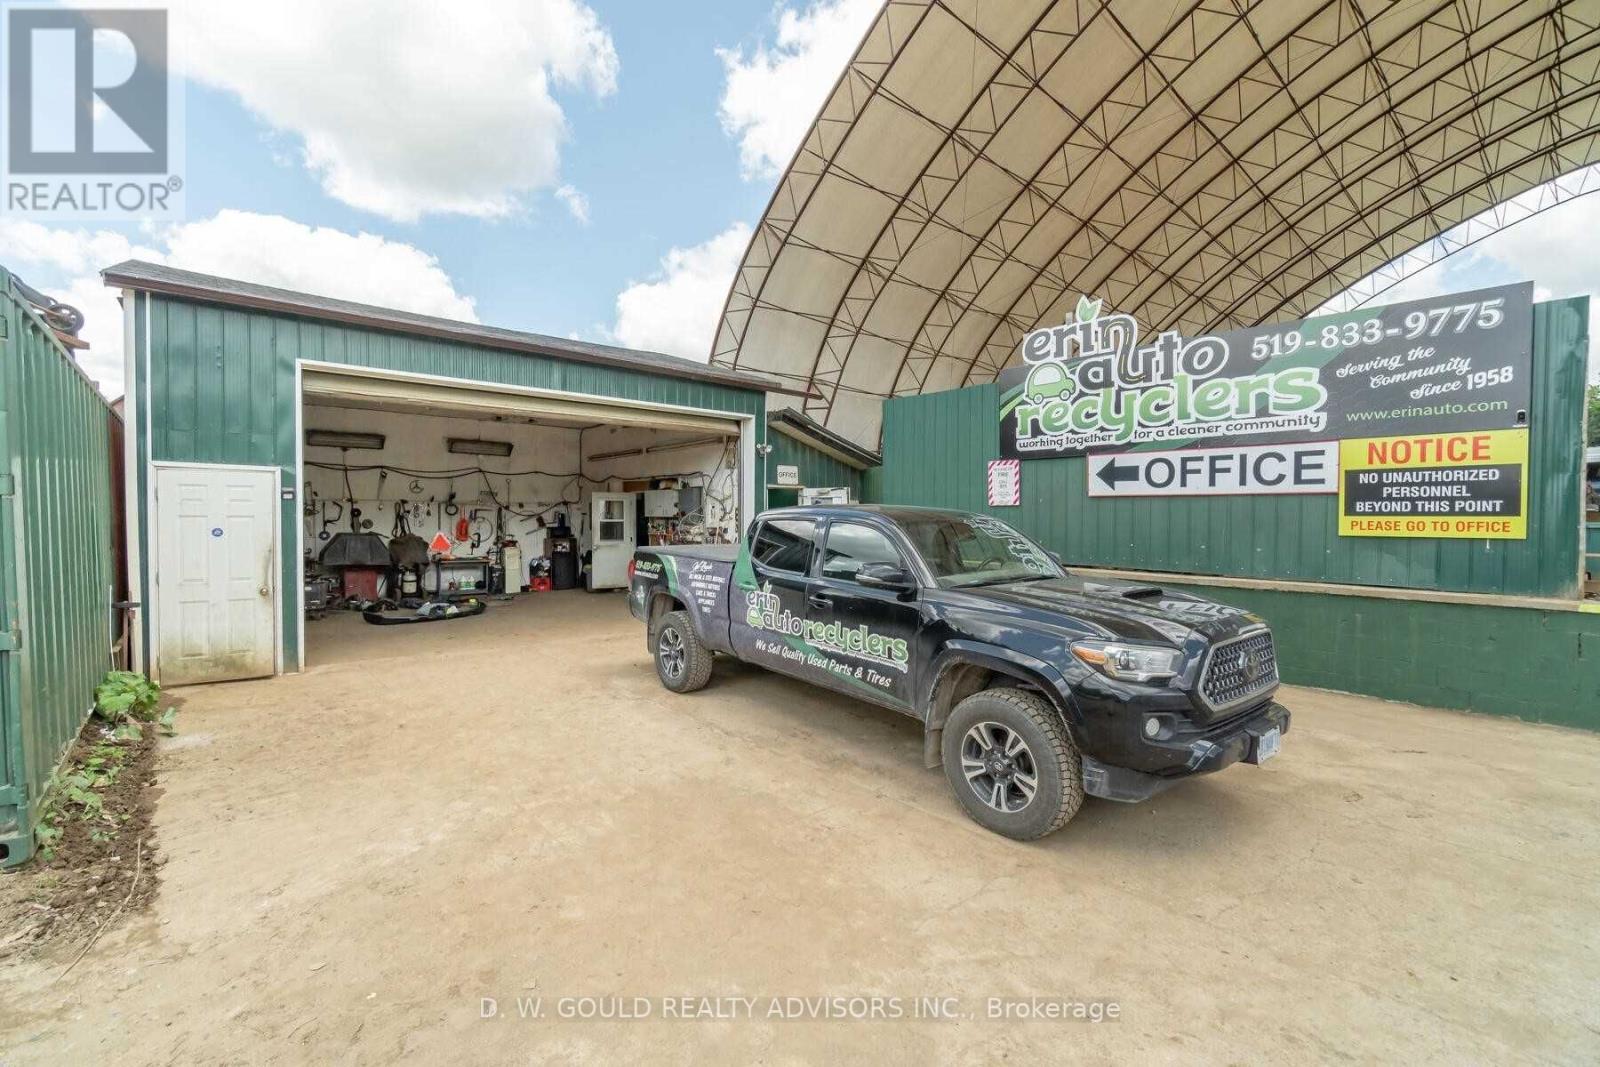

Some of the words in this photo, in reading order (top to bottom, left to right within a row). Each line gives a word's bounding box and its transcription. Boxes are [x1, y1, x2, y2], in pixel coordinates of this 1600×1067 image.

[1023, 300, 1138, 365] erin
[1251, 298, 1505, 362] 519-833-9775
[1078, 331, 1229, 394] auto
[1336, 354, 1404, 378] Serving
[1407, 346, 1435, 362] the
[1369, 356, 1472, 389] Community
[1410, 378, 1463, 399] Since
[1466, 366, 1514, 390] 1958
[1016, 367, 1327, 442] recyclers
[1346, 400, 1508, 422] www.erinauto.com
[1018, 437, 1064, 449] working
[1065, 433, 1114, 448] together
[1133, 429, 1154, 441] for
[1156, 430, 1165, 439] a
[1167, 424, 1222, 437] cleaner
[1225, 414, 1320, 434] community
[1367, 435, 1491, 465] NOTICE
[1144, 449, 1326, 489] OFFICE
[1359, 472, 1379, 484] NO
[1382, 468, 1500, 484] UNAUTHORIZED
[1355, 500, 1411, 512] BEYOND
[1415, 500, 1450, 512] THIS
[1454, 499, 1504, 512] POINT
[1382, 485, 1472, 498] PERSONNEL
[1350, 520, 1401, 531] PLEASE
[1406, 520, 1426, 532] GO
[1431, 520, 1449, 532] TO
[1455, 520, 1511, 533] OFFICE
[803, 619, 908, 663] recyclers
[755, 639, 766, 651] We
[768, 643, 781, 656] Sell
[781, 647, 806, 665] Quality
[807, 653, 828, 669] Used
[829, 659, 853, 676] Parts
[854, 667, 863, 679] &
[865, 669, 892, 688] Tires
